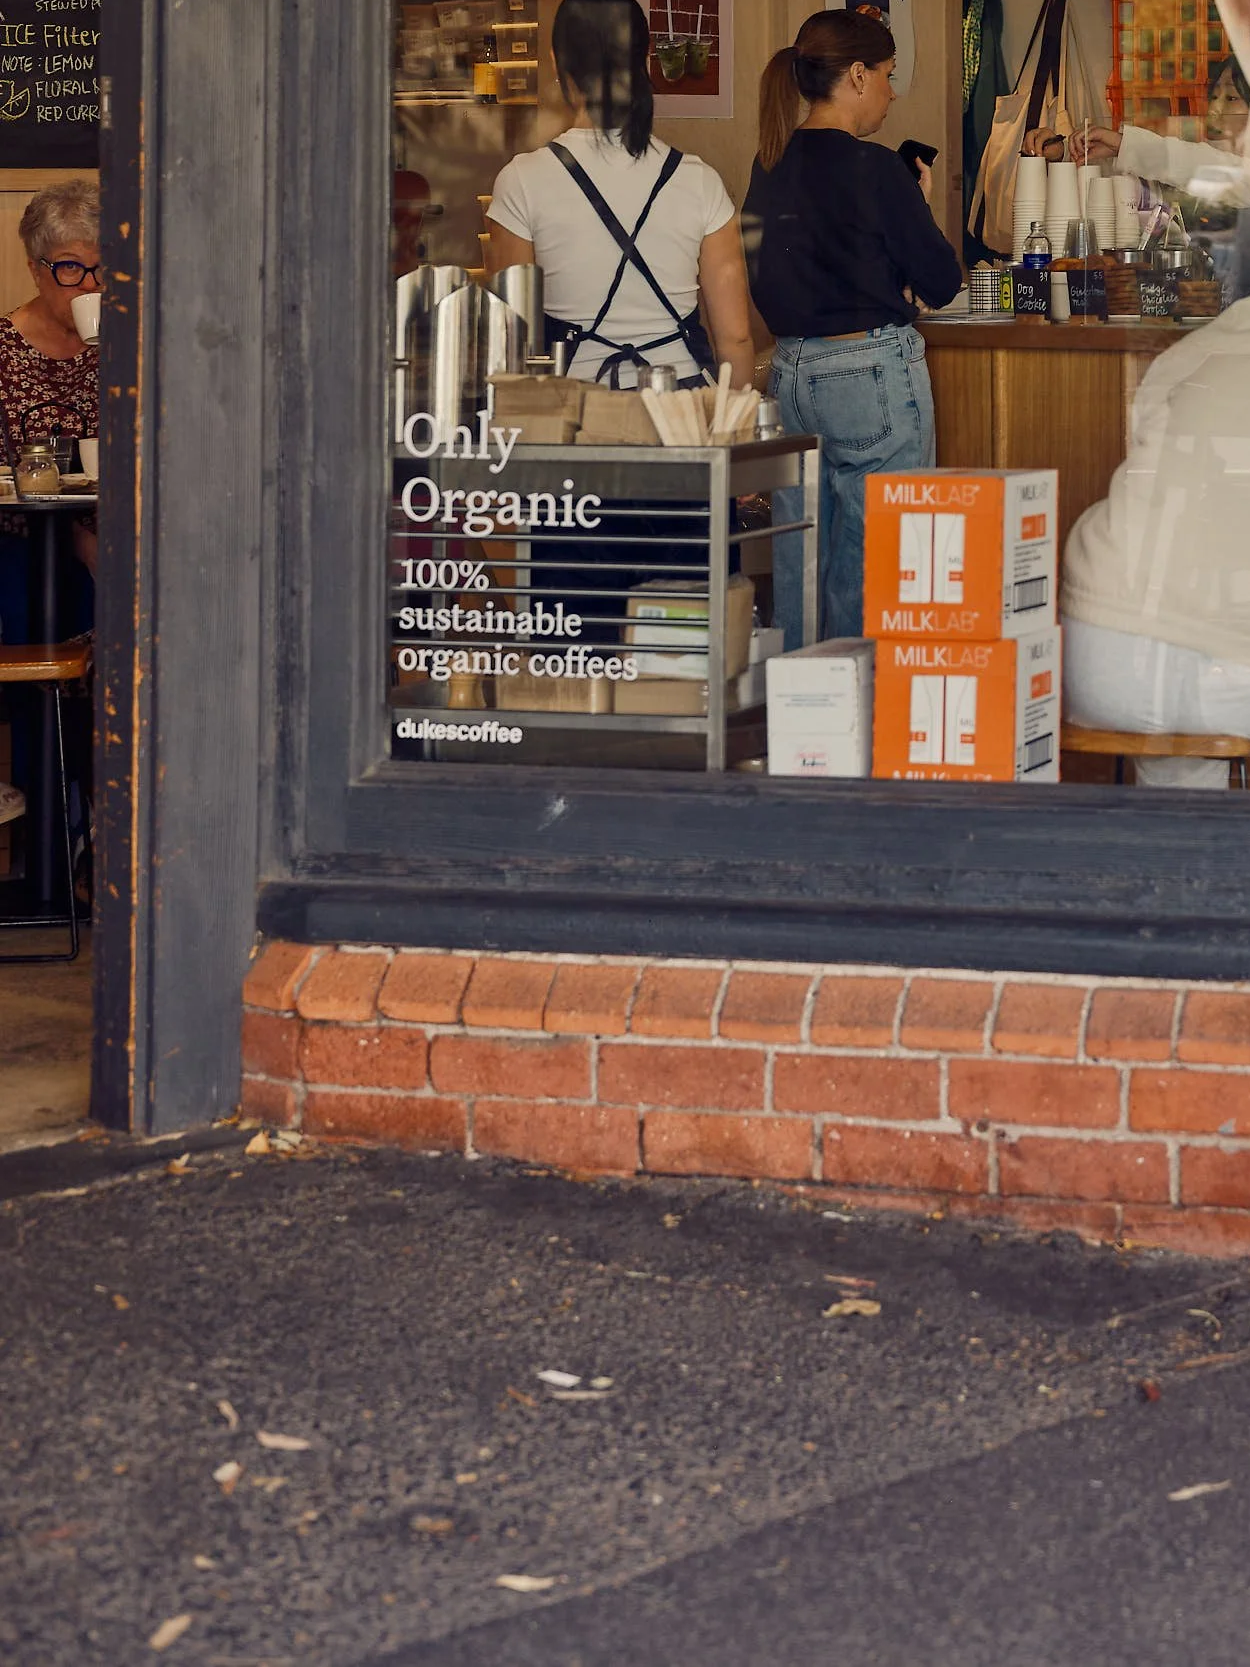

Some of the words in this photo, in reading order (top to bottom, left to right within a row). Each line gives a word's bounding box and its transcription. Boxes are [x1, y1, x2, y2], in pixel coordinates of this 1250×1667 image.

[44, 24, 100, 48] Filter
[36, 104, 63, 122] RED
[1017, 283, 1034, 298] Dog
[1017, 297, 1047, 311] Cookie
[403, 409, 523, 474] Only
[401, 477, 601, 538] Organic
[884, 483, 981, 508] MILKLAB
[400, 558, 490, 591] 100%
[399, 601, 582, 637] sustainable
[882, 610, 980, 633] MILKLAB
[398, 643, 520, 681] organic
[528, 645, 638, 681] coffees
[894, 645, 993, 668] MILKLAB
[396, 718, 523, 744] dukescoffee
